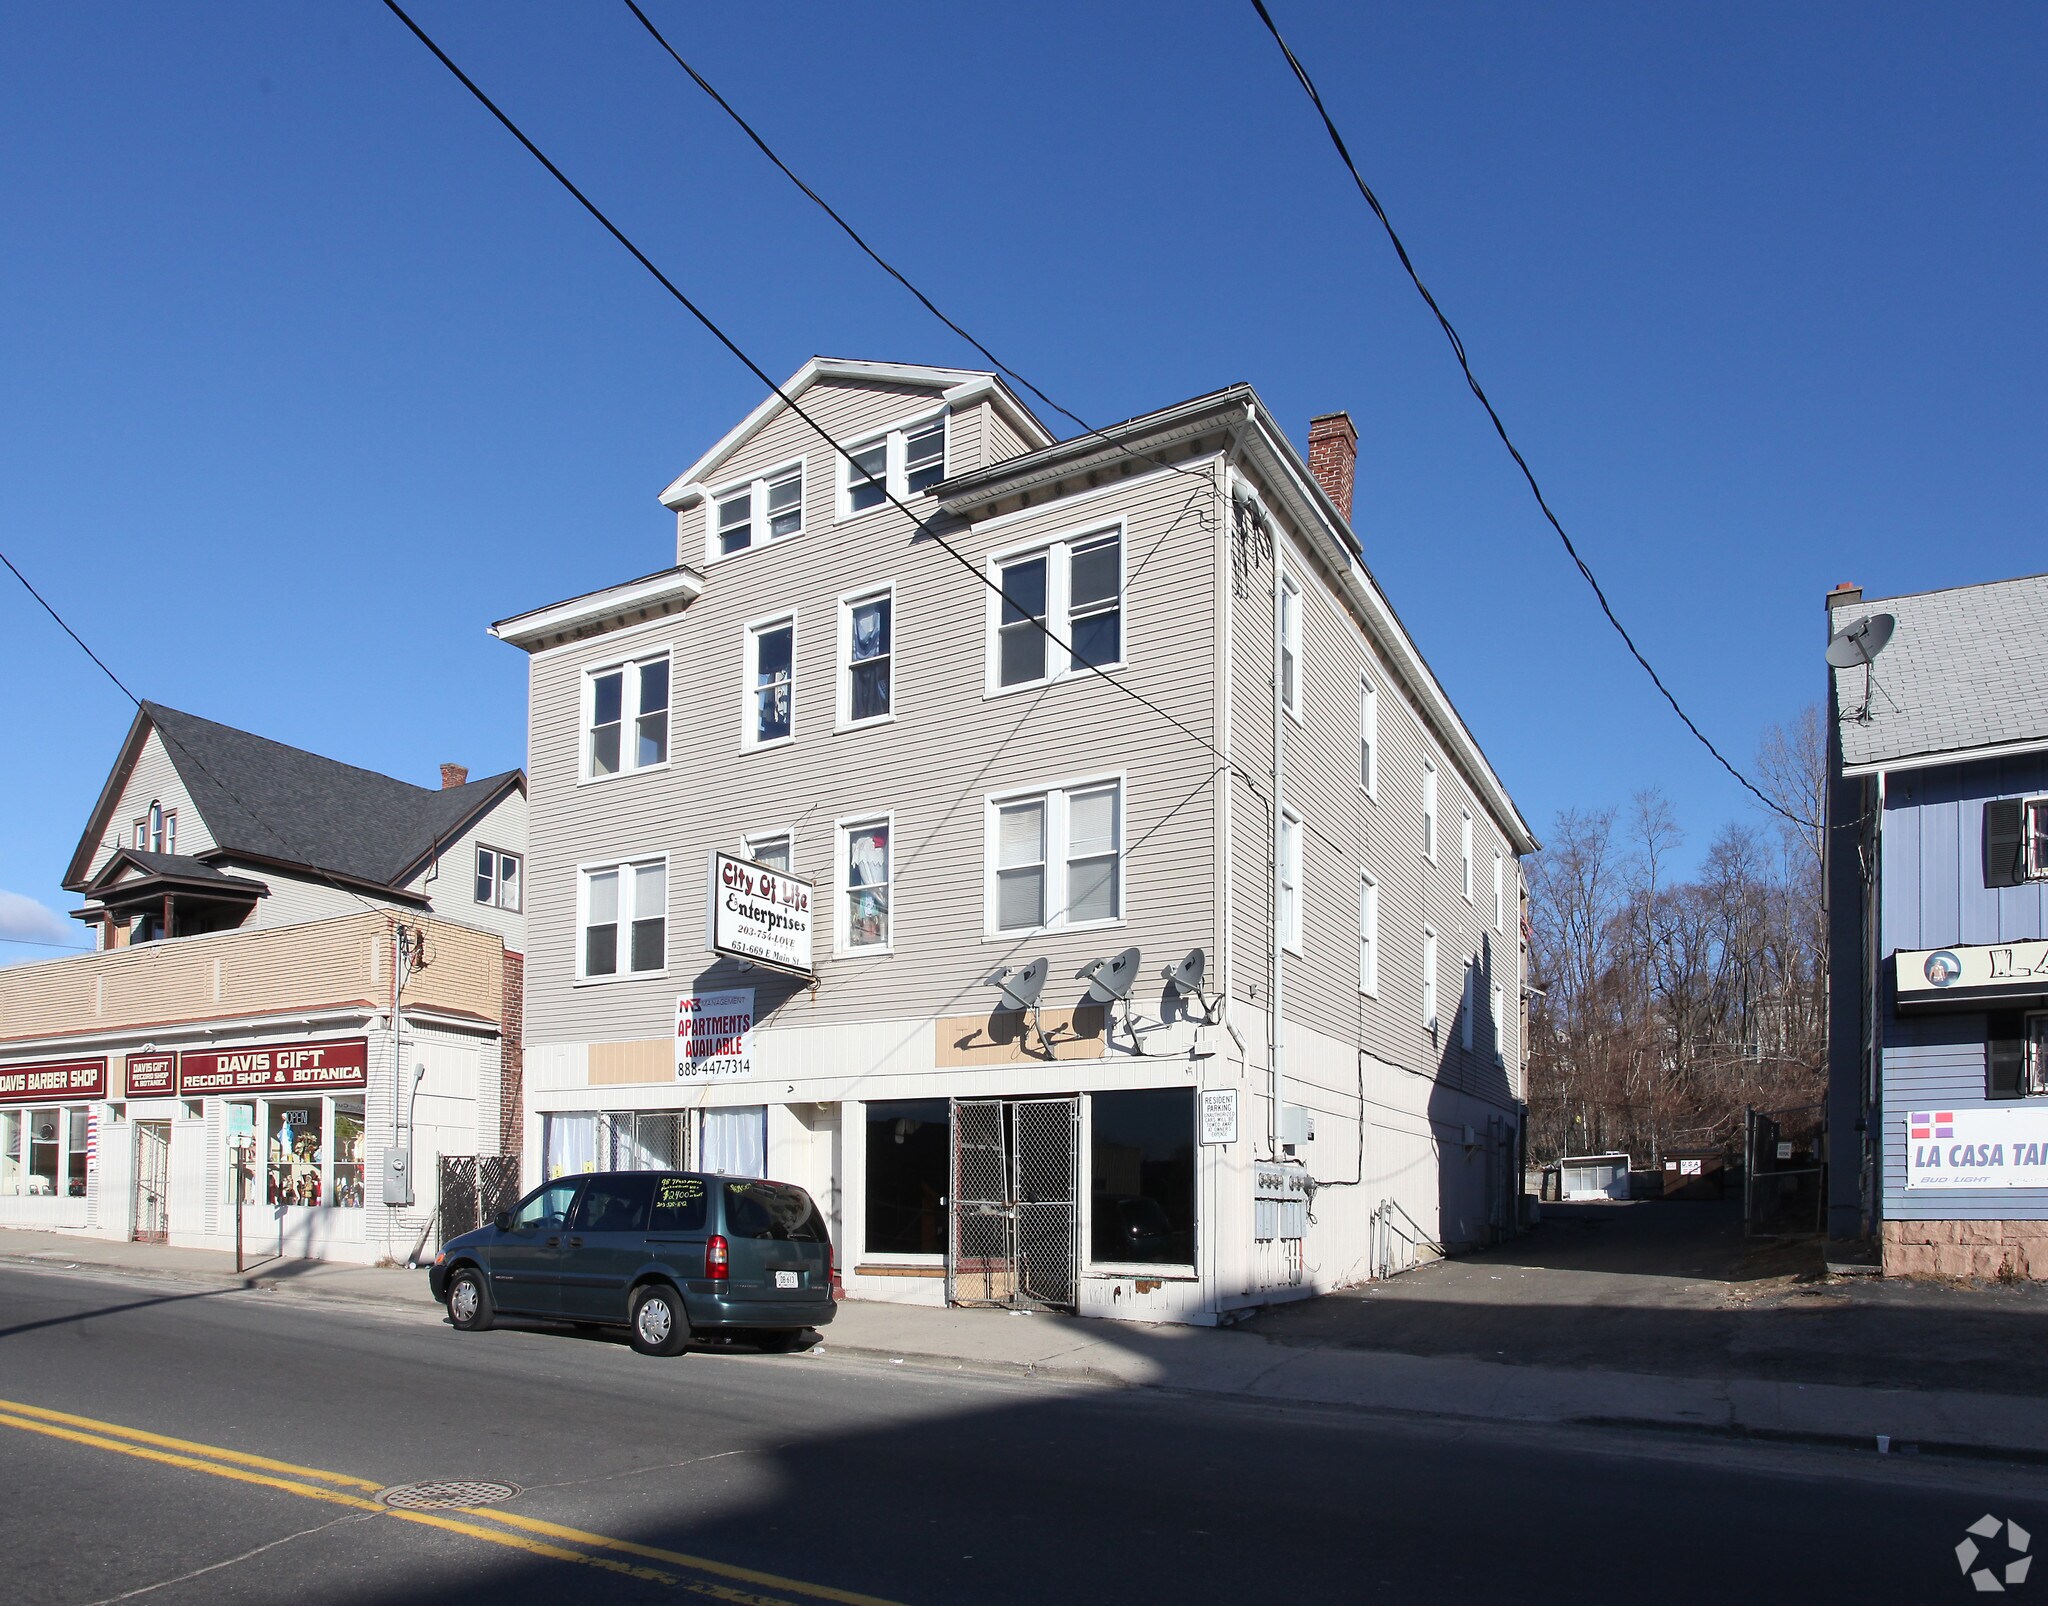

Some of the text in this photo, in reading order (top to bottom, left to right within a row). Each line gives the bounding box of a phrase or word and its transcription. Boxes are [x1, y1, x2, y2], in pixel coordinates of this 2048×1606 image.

[722, 862, 808, 912] City Of Life
[725, 892, 806, 932] Enterprises
[737, 925, 796, 948] 203-754-LOVE
[731, 940, 764, 956] 651-669
[765, 949, 771, 958] E
[773, 950, 790, 963] Main
[702, 997, 746, 1007] MANAGEMENT
[678, 1014, 751, 1037] APARTMENTS
[685, 1036, 743, 1058] AVAILABLE
[133, 1061, 169, 1074] DAVIS GIFT
[217, 1049, 325, 1073] DAVIS GIFT
[678, 1059, 750, 1077] 888-447-7314
[0, 1069, 98, 1092] DAVIS BARBER SHOP
[132, 1073, 154, 1081] RECORD
[140, 1079, 167, 1087] BOTANICA
[183, 1066, 363, 1088] RECORD SHOP & BOTANICA
[1205, 1096, 1233, 1104] RESIDENT
[1207, 1104, 1231, 1112] PARKING
[287, 1111, 307, 1124] OPEN
[1915, 1145, 1941, 1168] LA
[1948, 1144, 2004, 1168] CASA
[1920, 1176, 1948, 1184] BUD
